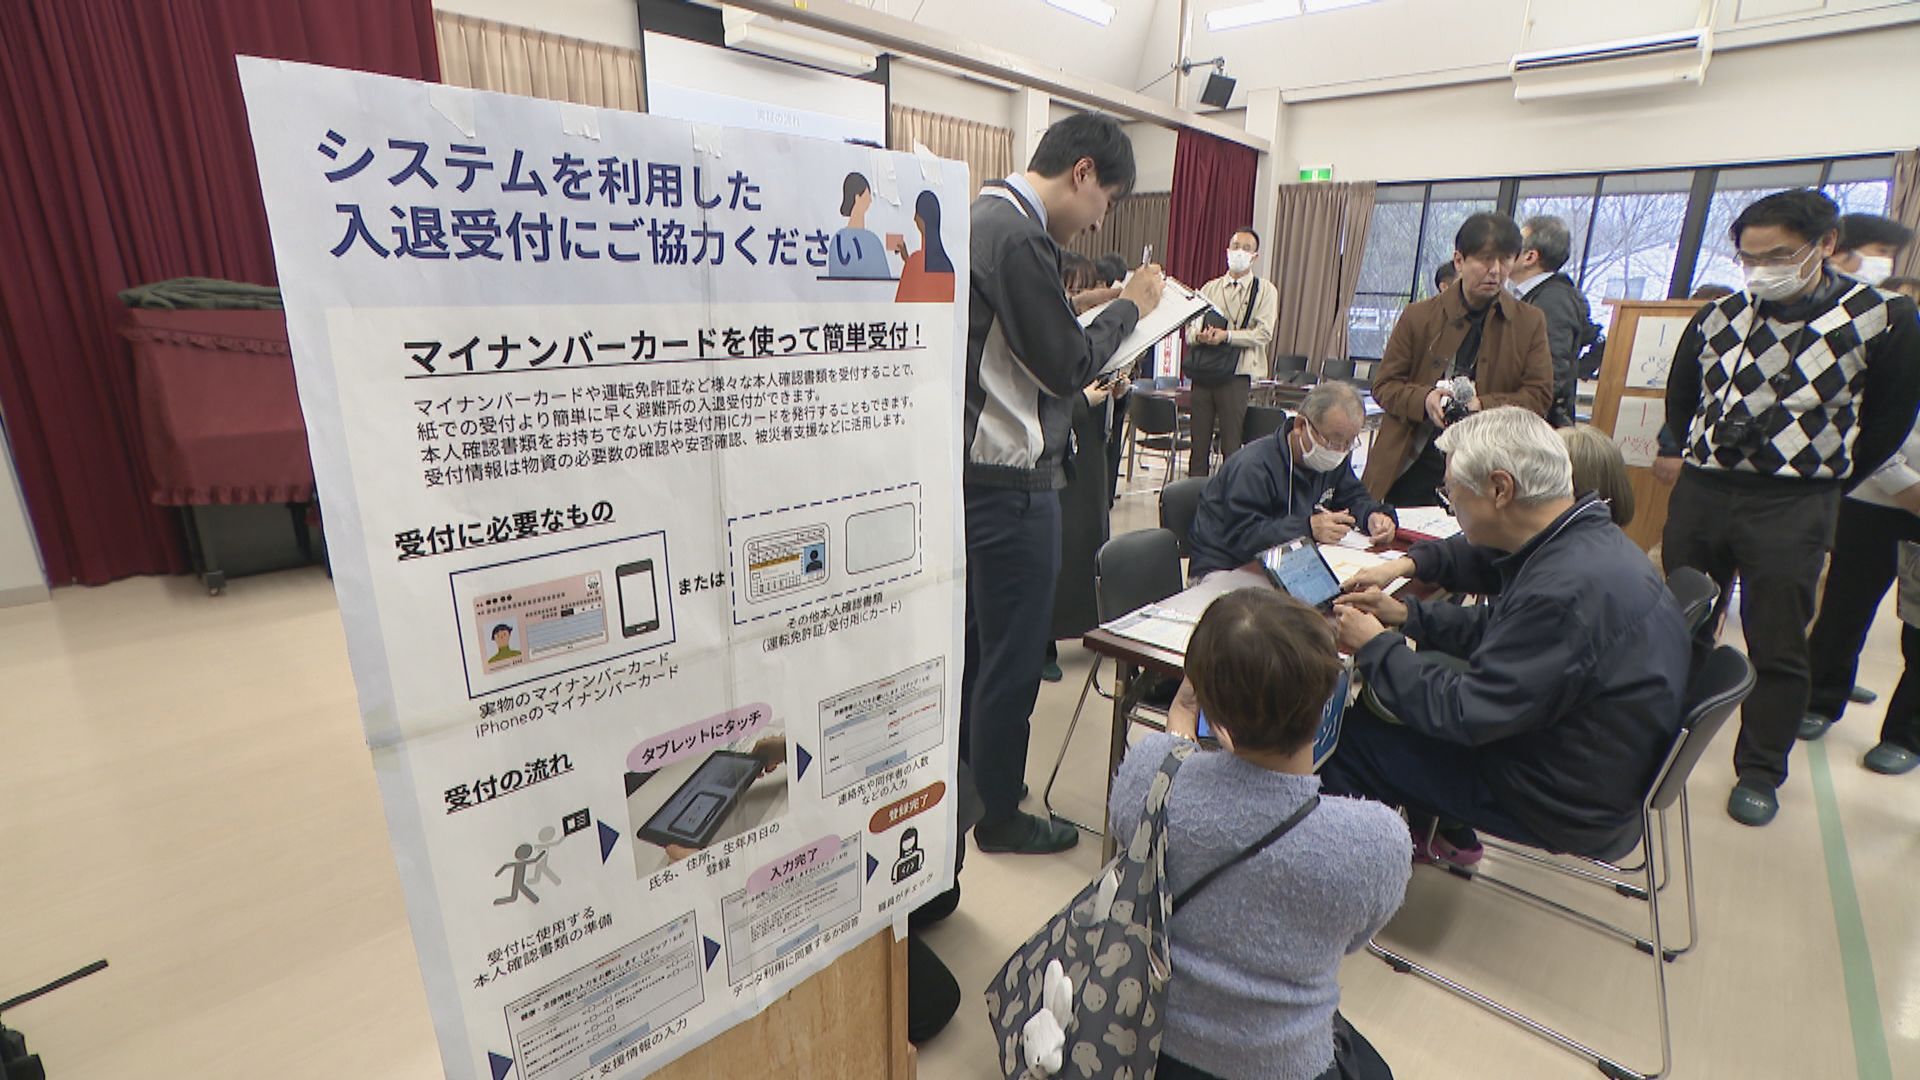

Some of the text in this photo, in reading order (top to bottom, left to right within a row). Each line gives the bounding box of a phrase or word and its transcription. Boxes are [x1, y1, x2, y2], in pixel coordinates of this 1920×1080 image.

[317, 129, 761, 211] システムを利用した
[330, 201, 863, 267] 入退受付にご協力ください
[404, 322, 922, 374] マイナンバーカードを使って簡単受付！
[414, 364, 914, 417] マイナンバーカードや運転免許証など様々な本人確認書類を受付することで、
[417, 389, 820, 441] 紙での受付より簡単に早く避難所の入退受付ができます。
[421, 396, 914, 463] 本人確認書類をお持ちでない方は受付用ICカードを発行することもできます。
[424, 413, 906, 488] 受付情報は物資の必要数の確認や安否確認、被災者支援などに活用します。
[395, 500, 614, 558] 受付に必要なもの
[678, 571, 725, 596] または
[787, 592, 883, 629] その他本人確認書類
[475, 665, 679, 737] iPhoneのマイナンバーカード
[479, 652, 668, 719] 実物のマイナンバーカード
[641, 710, 762, 765] タブレットにタッチ
[444, 753, 573, 812] 受付の流れ
[862, 779, 908, 805] などの入力
[649, 823, 779, 891] 氏名、住所、生年月日の
[706, 857, 731, 876] 登録
[770, 848, 817, 881] 入力完了
[474, 913, 613, 987] 本人確認書類の準備
[487, 906, 595, 966] 受付に使用する
